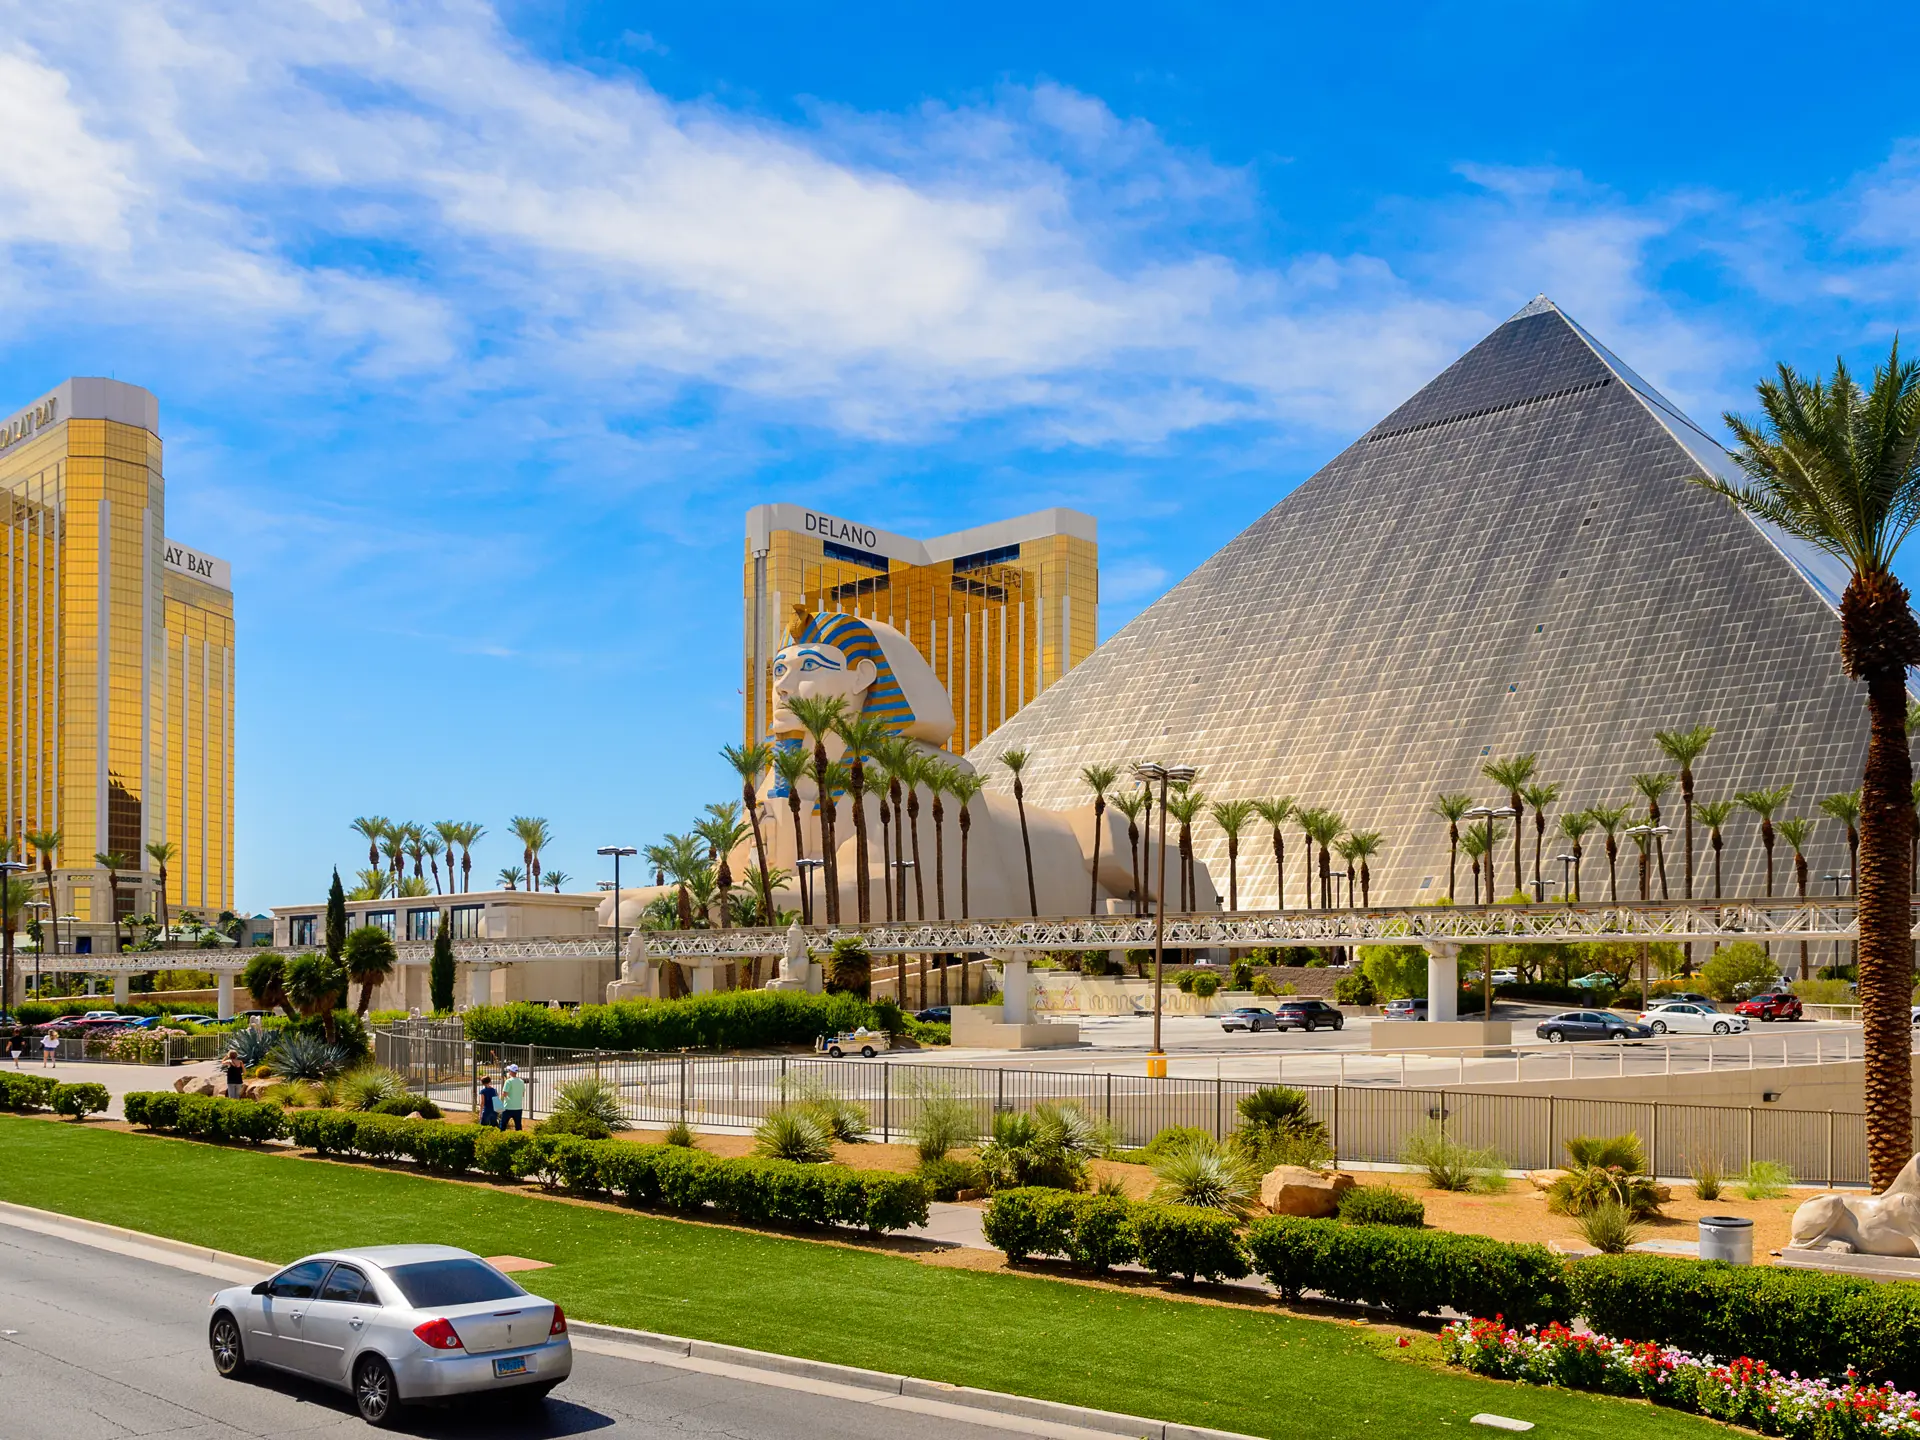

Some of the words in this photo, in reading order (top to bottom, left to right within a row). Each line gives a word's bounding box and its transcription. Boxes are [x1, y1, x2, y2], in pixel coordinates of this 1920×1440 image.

[35, 396, 57, 430] BAY
[805, 512, 877, 548] DELANO
[187, 552, 214, 578] BAY
